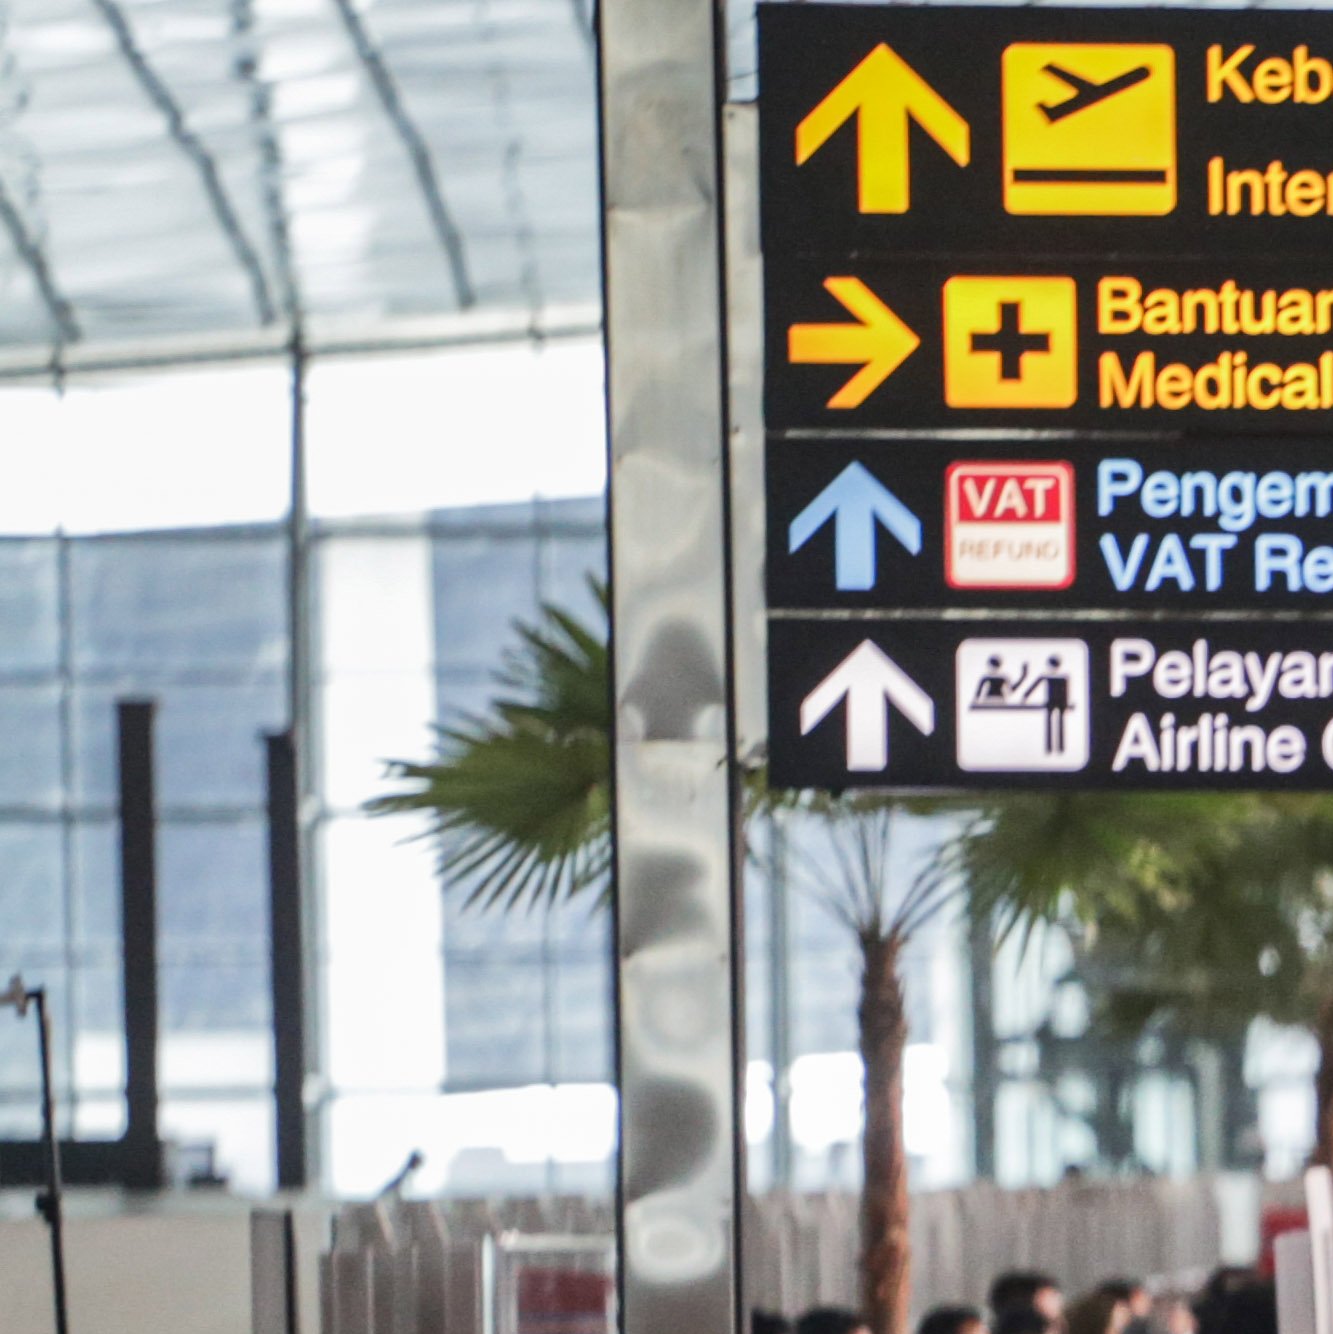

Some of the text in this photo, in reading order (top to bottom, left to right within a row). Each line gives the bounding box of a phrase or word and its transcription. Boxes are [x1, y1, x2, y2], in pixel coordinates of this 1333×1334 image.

[962, 476, 1057, 519] VAT
[959, 539, 1060, 561] REFUND
[1099, 532, 1244, 592] VAT
[1112, 711, 1307, 773] Airline
